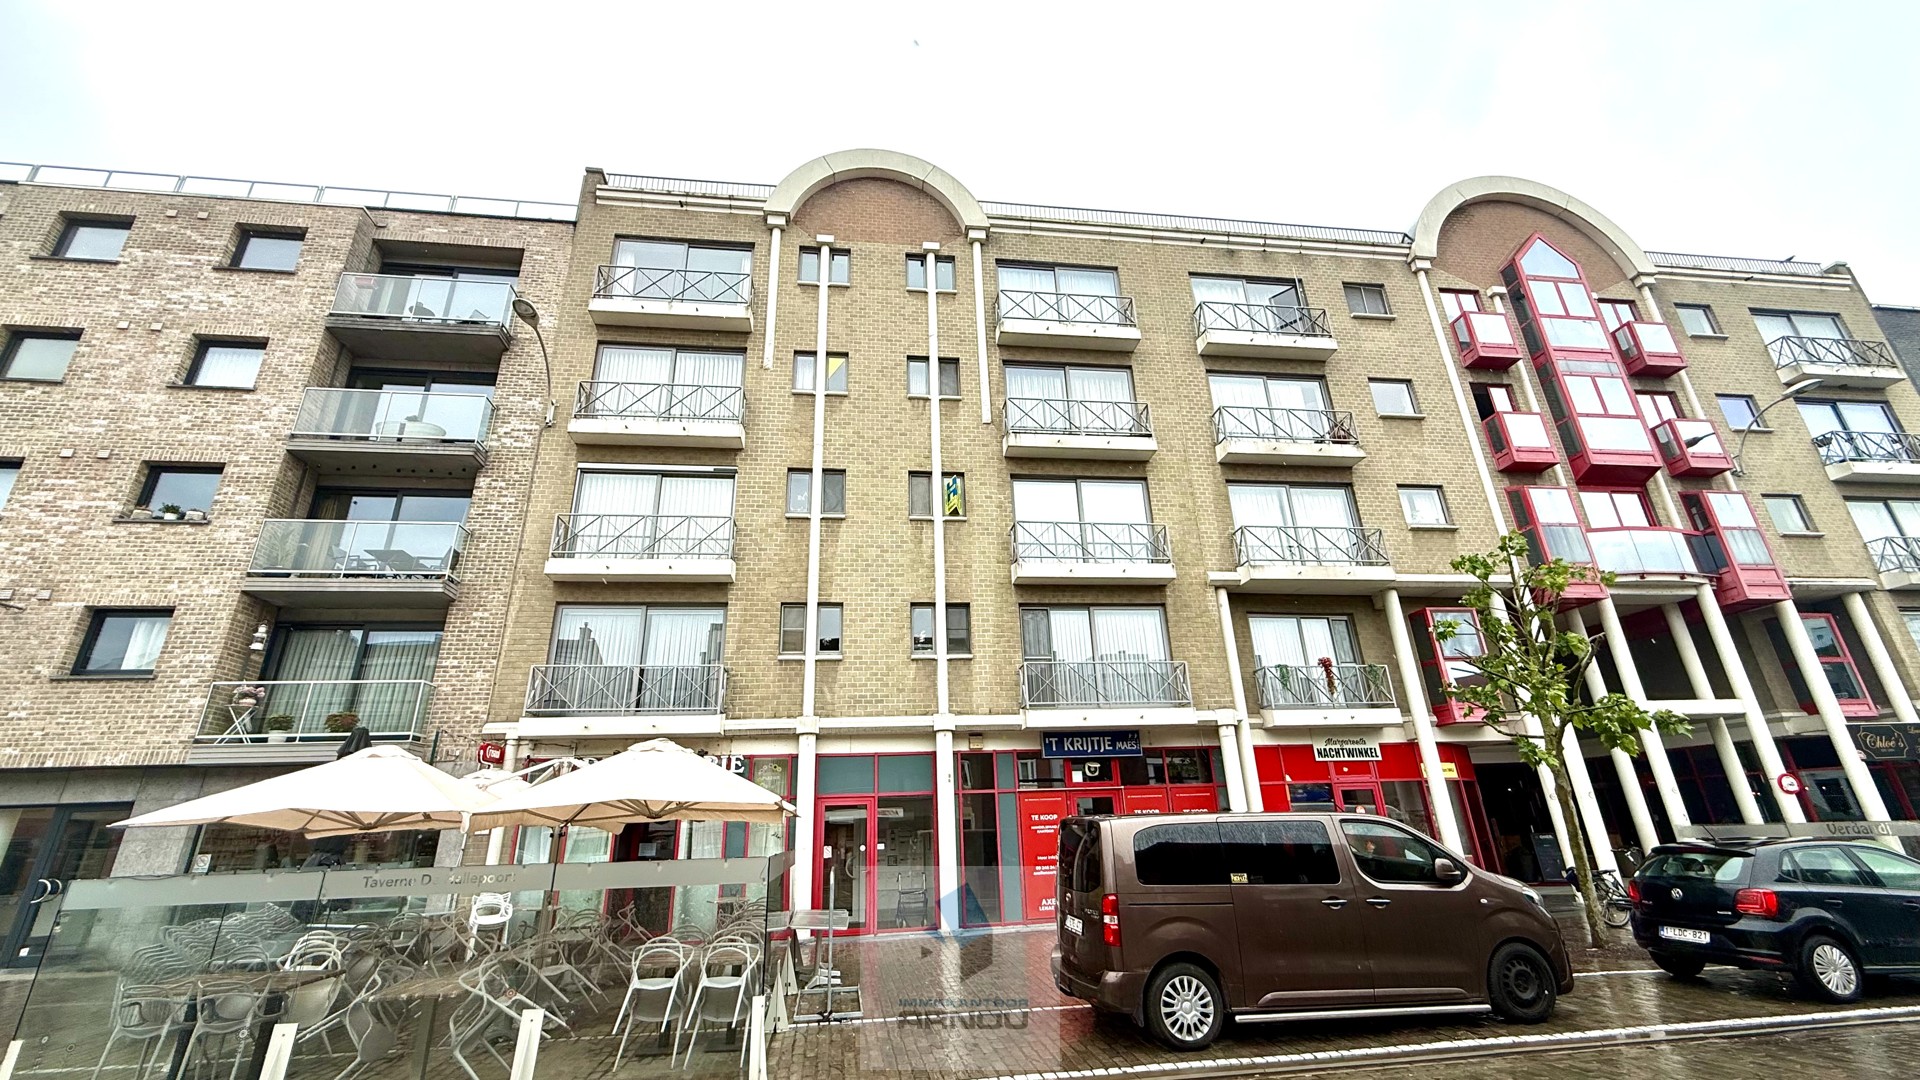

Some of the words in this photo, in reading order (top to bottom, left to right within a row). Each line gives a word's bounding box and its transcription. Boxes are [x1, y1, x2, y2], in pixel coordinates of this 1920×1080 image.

[1046, 738, 1058, 751] 'T
[1063, 737, 1113, 753] KRIJTJE
[1116, 741, 1136, 750] MAES
[1316, 747, 1379, 758] NACHTWINKEL
[363, 875, 416, 889] Taverne
